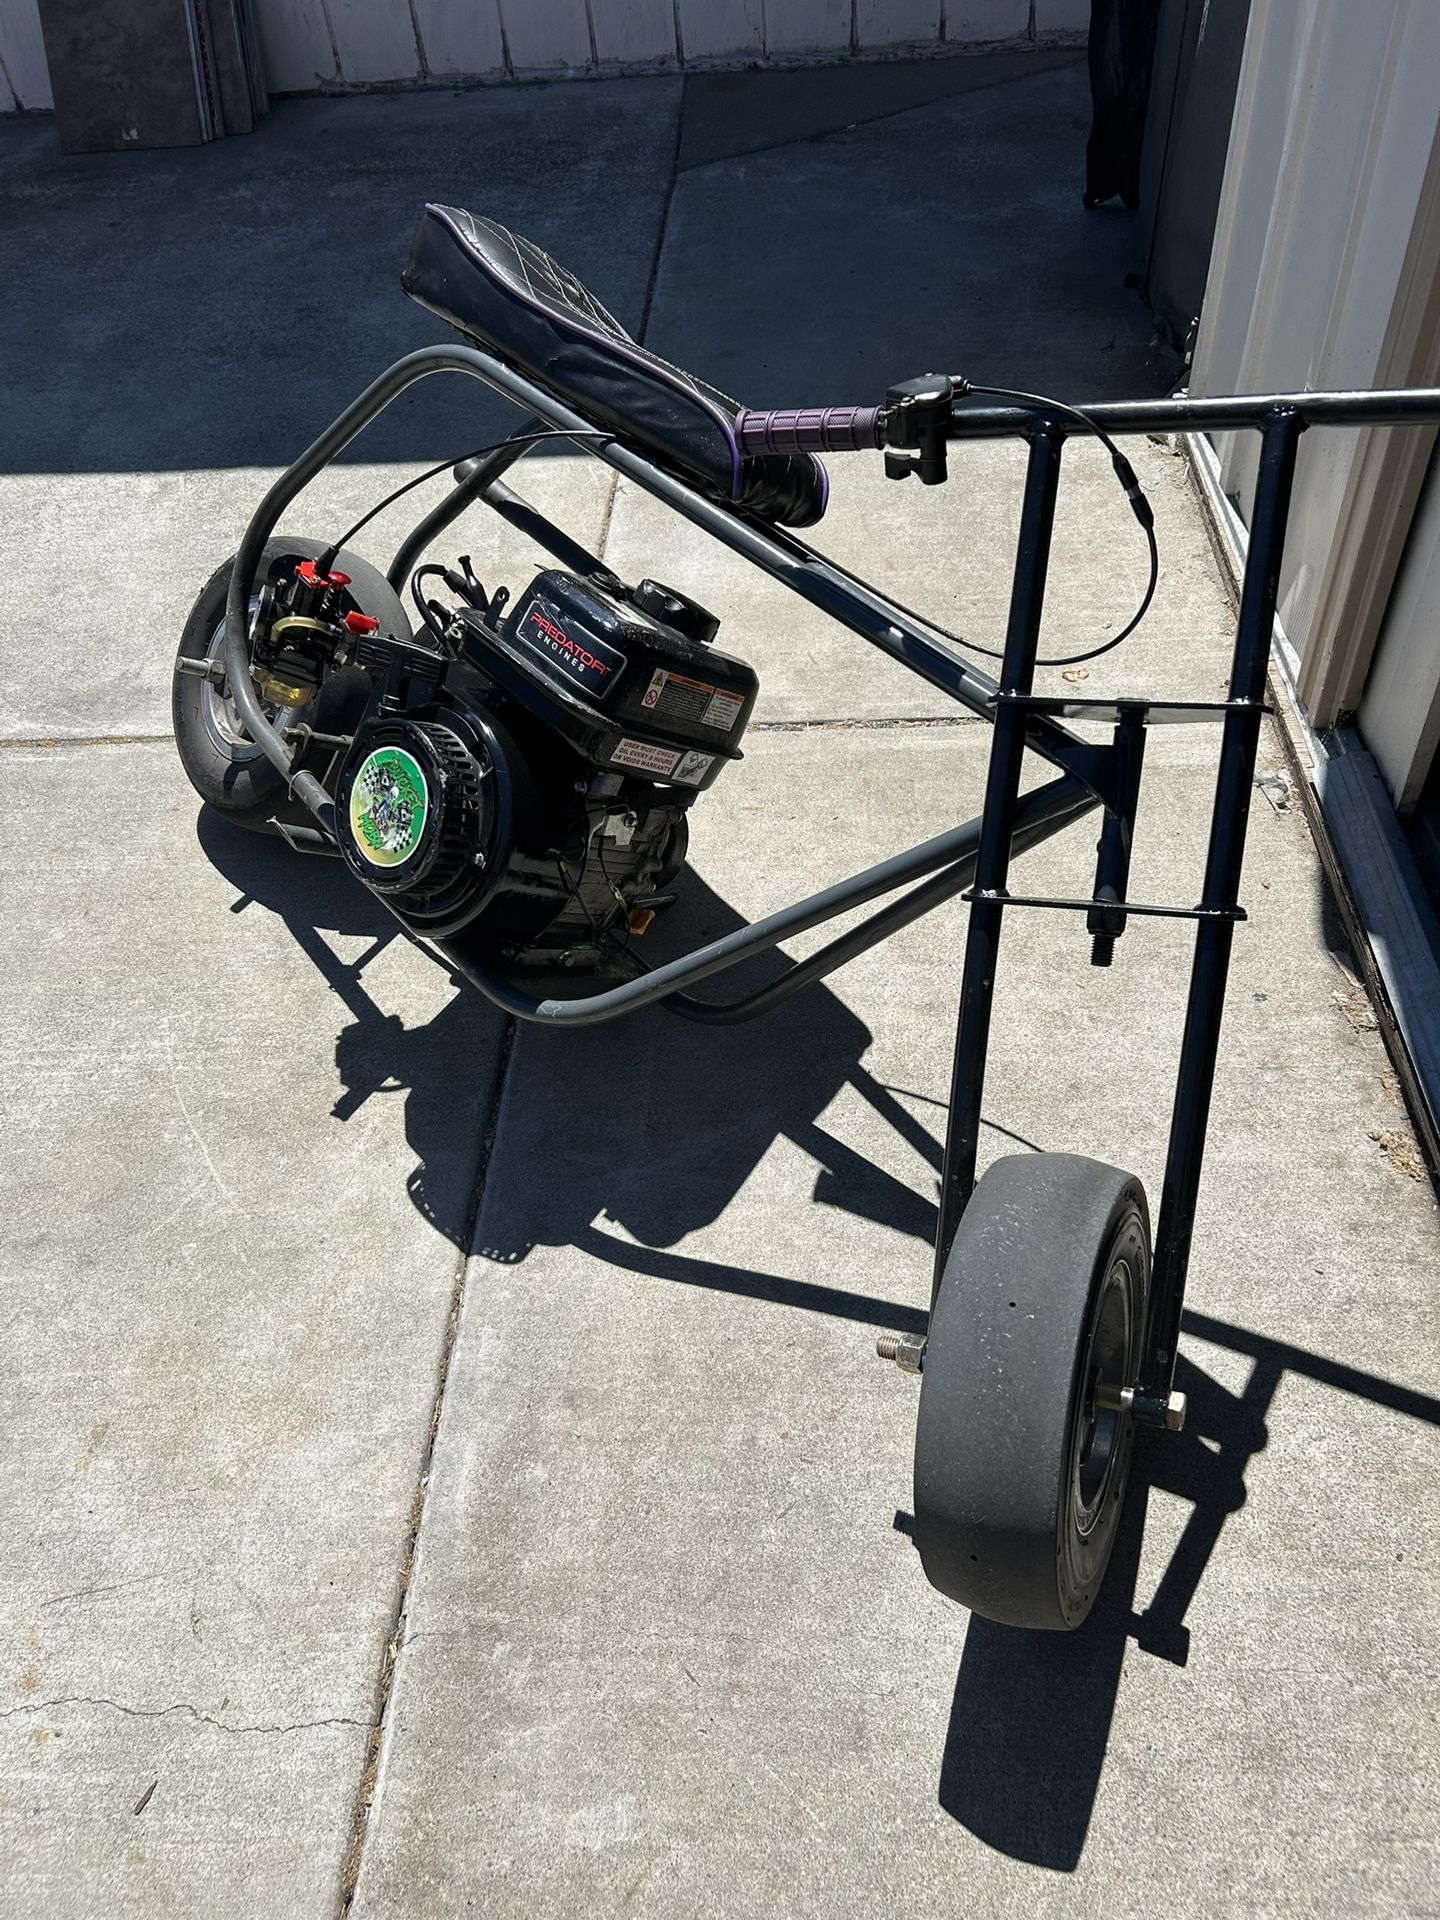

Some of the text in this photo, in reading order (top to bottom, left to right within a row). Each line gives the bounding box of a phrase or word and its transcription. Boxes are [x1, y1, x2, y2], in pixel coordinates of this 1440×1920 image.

[531, 612, 606, 675] PREDATOR
[536, 630, 586, 672] ENGINES
[613, 753, 623, 761] OR
[640, 761, 671, 773] WARRANTY
[619, 747, 628, 755] OIL
[630, 750, 648, 760] EVERY
[653, 756, 673, 766] HOURS
[624, 741, 675, 759] USER MUST CHECK
[381, 758, 424, 809] BUCKET
